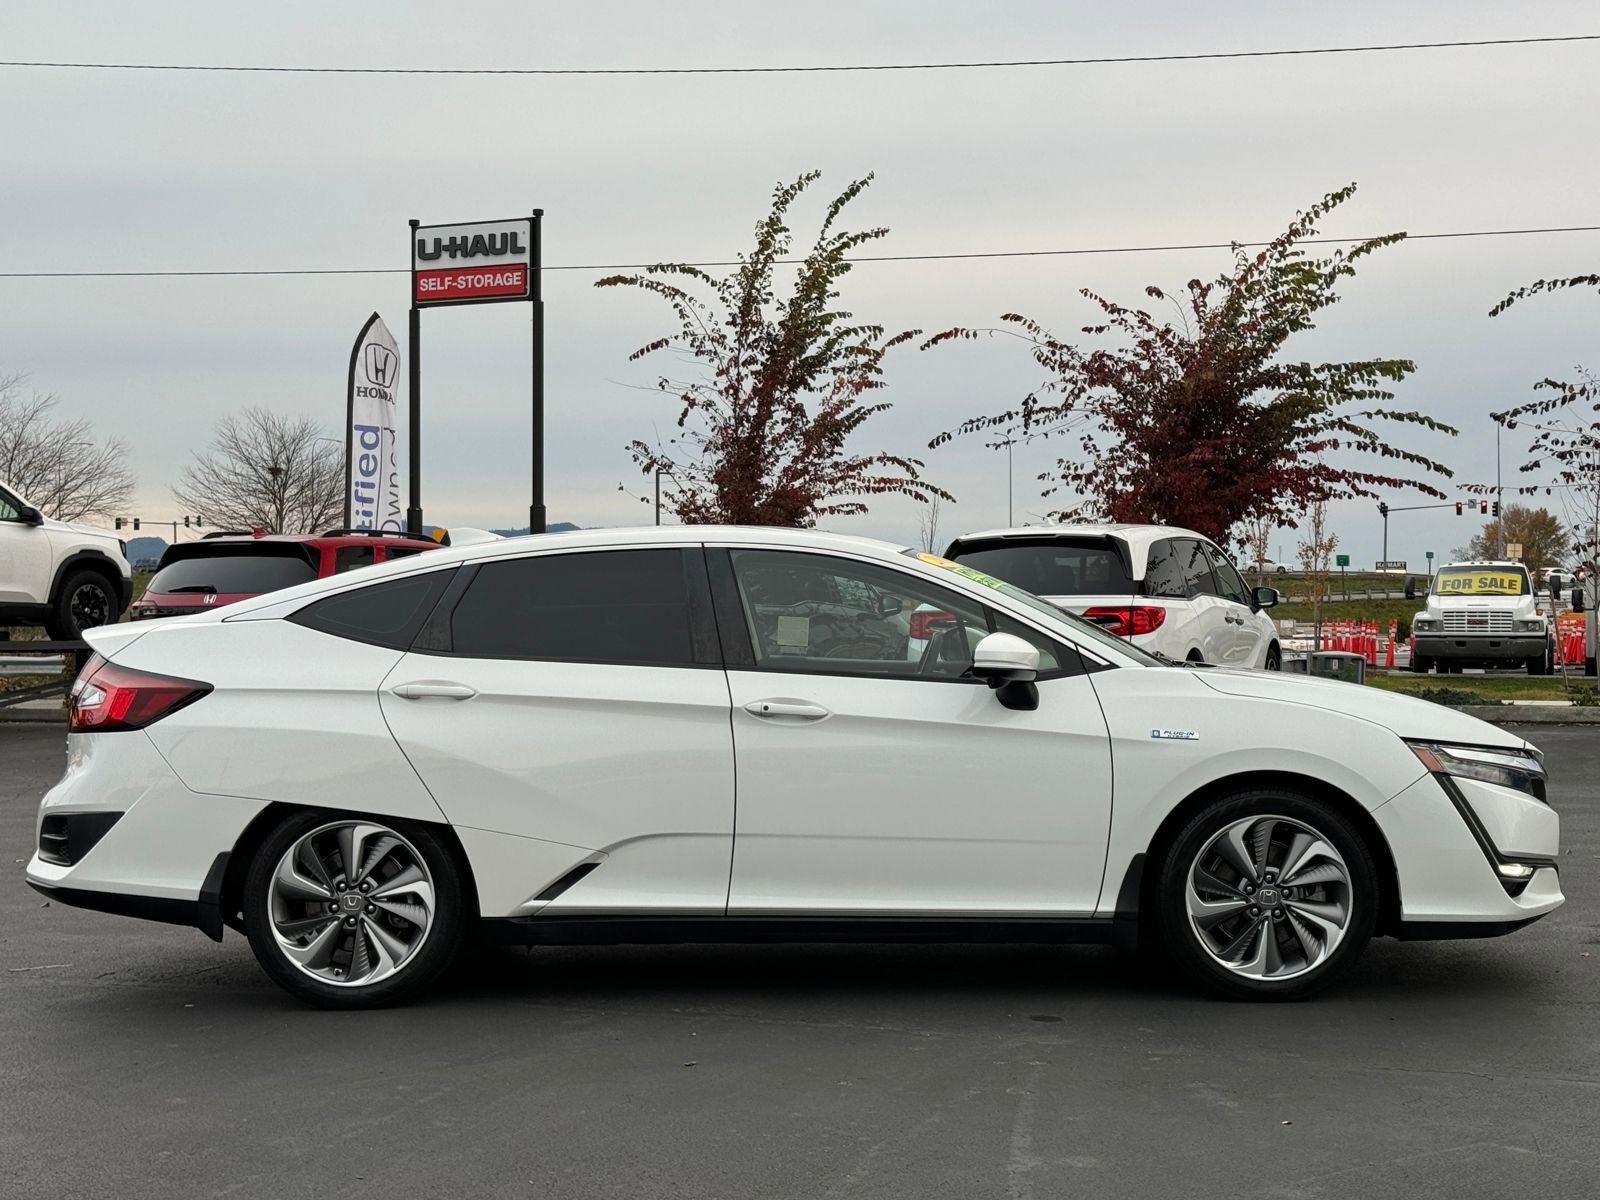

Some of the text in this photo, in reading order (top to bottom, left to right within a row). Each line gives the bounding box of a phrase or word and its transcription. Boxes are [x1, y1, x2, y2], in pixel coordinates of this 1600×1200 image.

[417, 231, 526, 261] U-HAUL
[419, 272, 522, 292] SELF-STORAGE
[1441, 577, 1518, 590] FOR SALE
